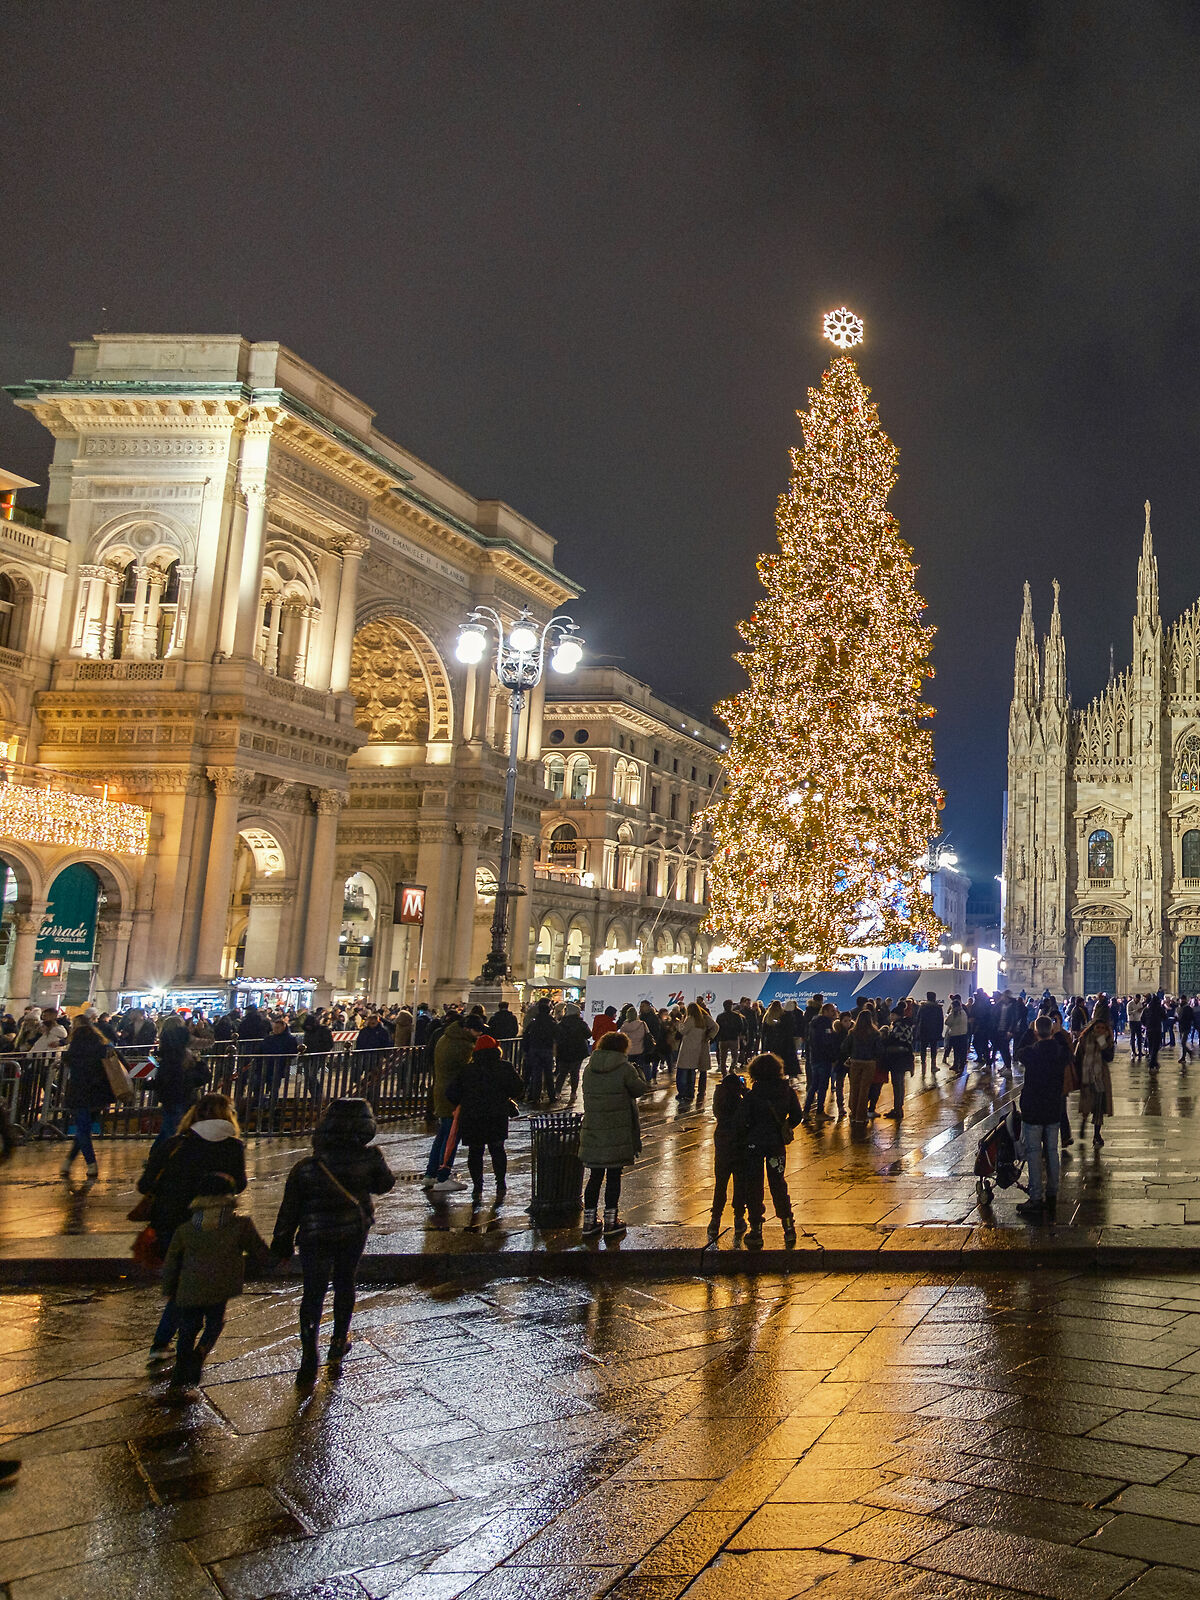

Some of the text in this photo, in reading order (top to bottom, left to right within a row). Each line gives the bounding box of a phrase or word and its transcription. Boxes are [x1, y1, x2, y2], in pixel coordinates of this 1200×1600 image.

[370, 525, 390, 541] TORIO
[392, 537, 424, 561] EMANUELE
[554, 842, 577, 850] APERO
[403, 894, 423, 917] M
[44, 962, 59, 973] M
[774, 991, 798, 999] Olympic
